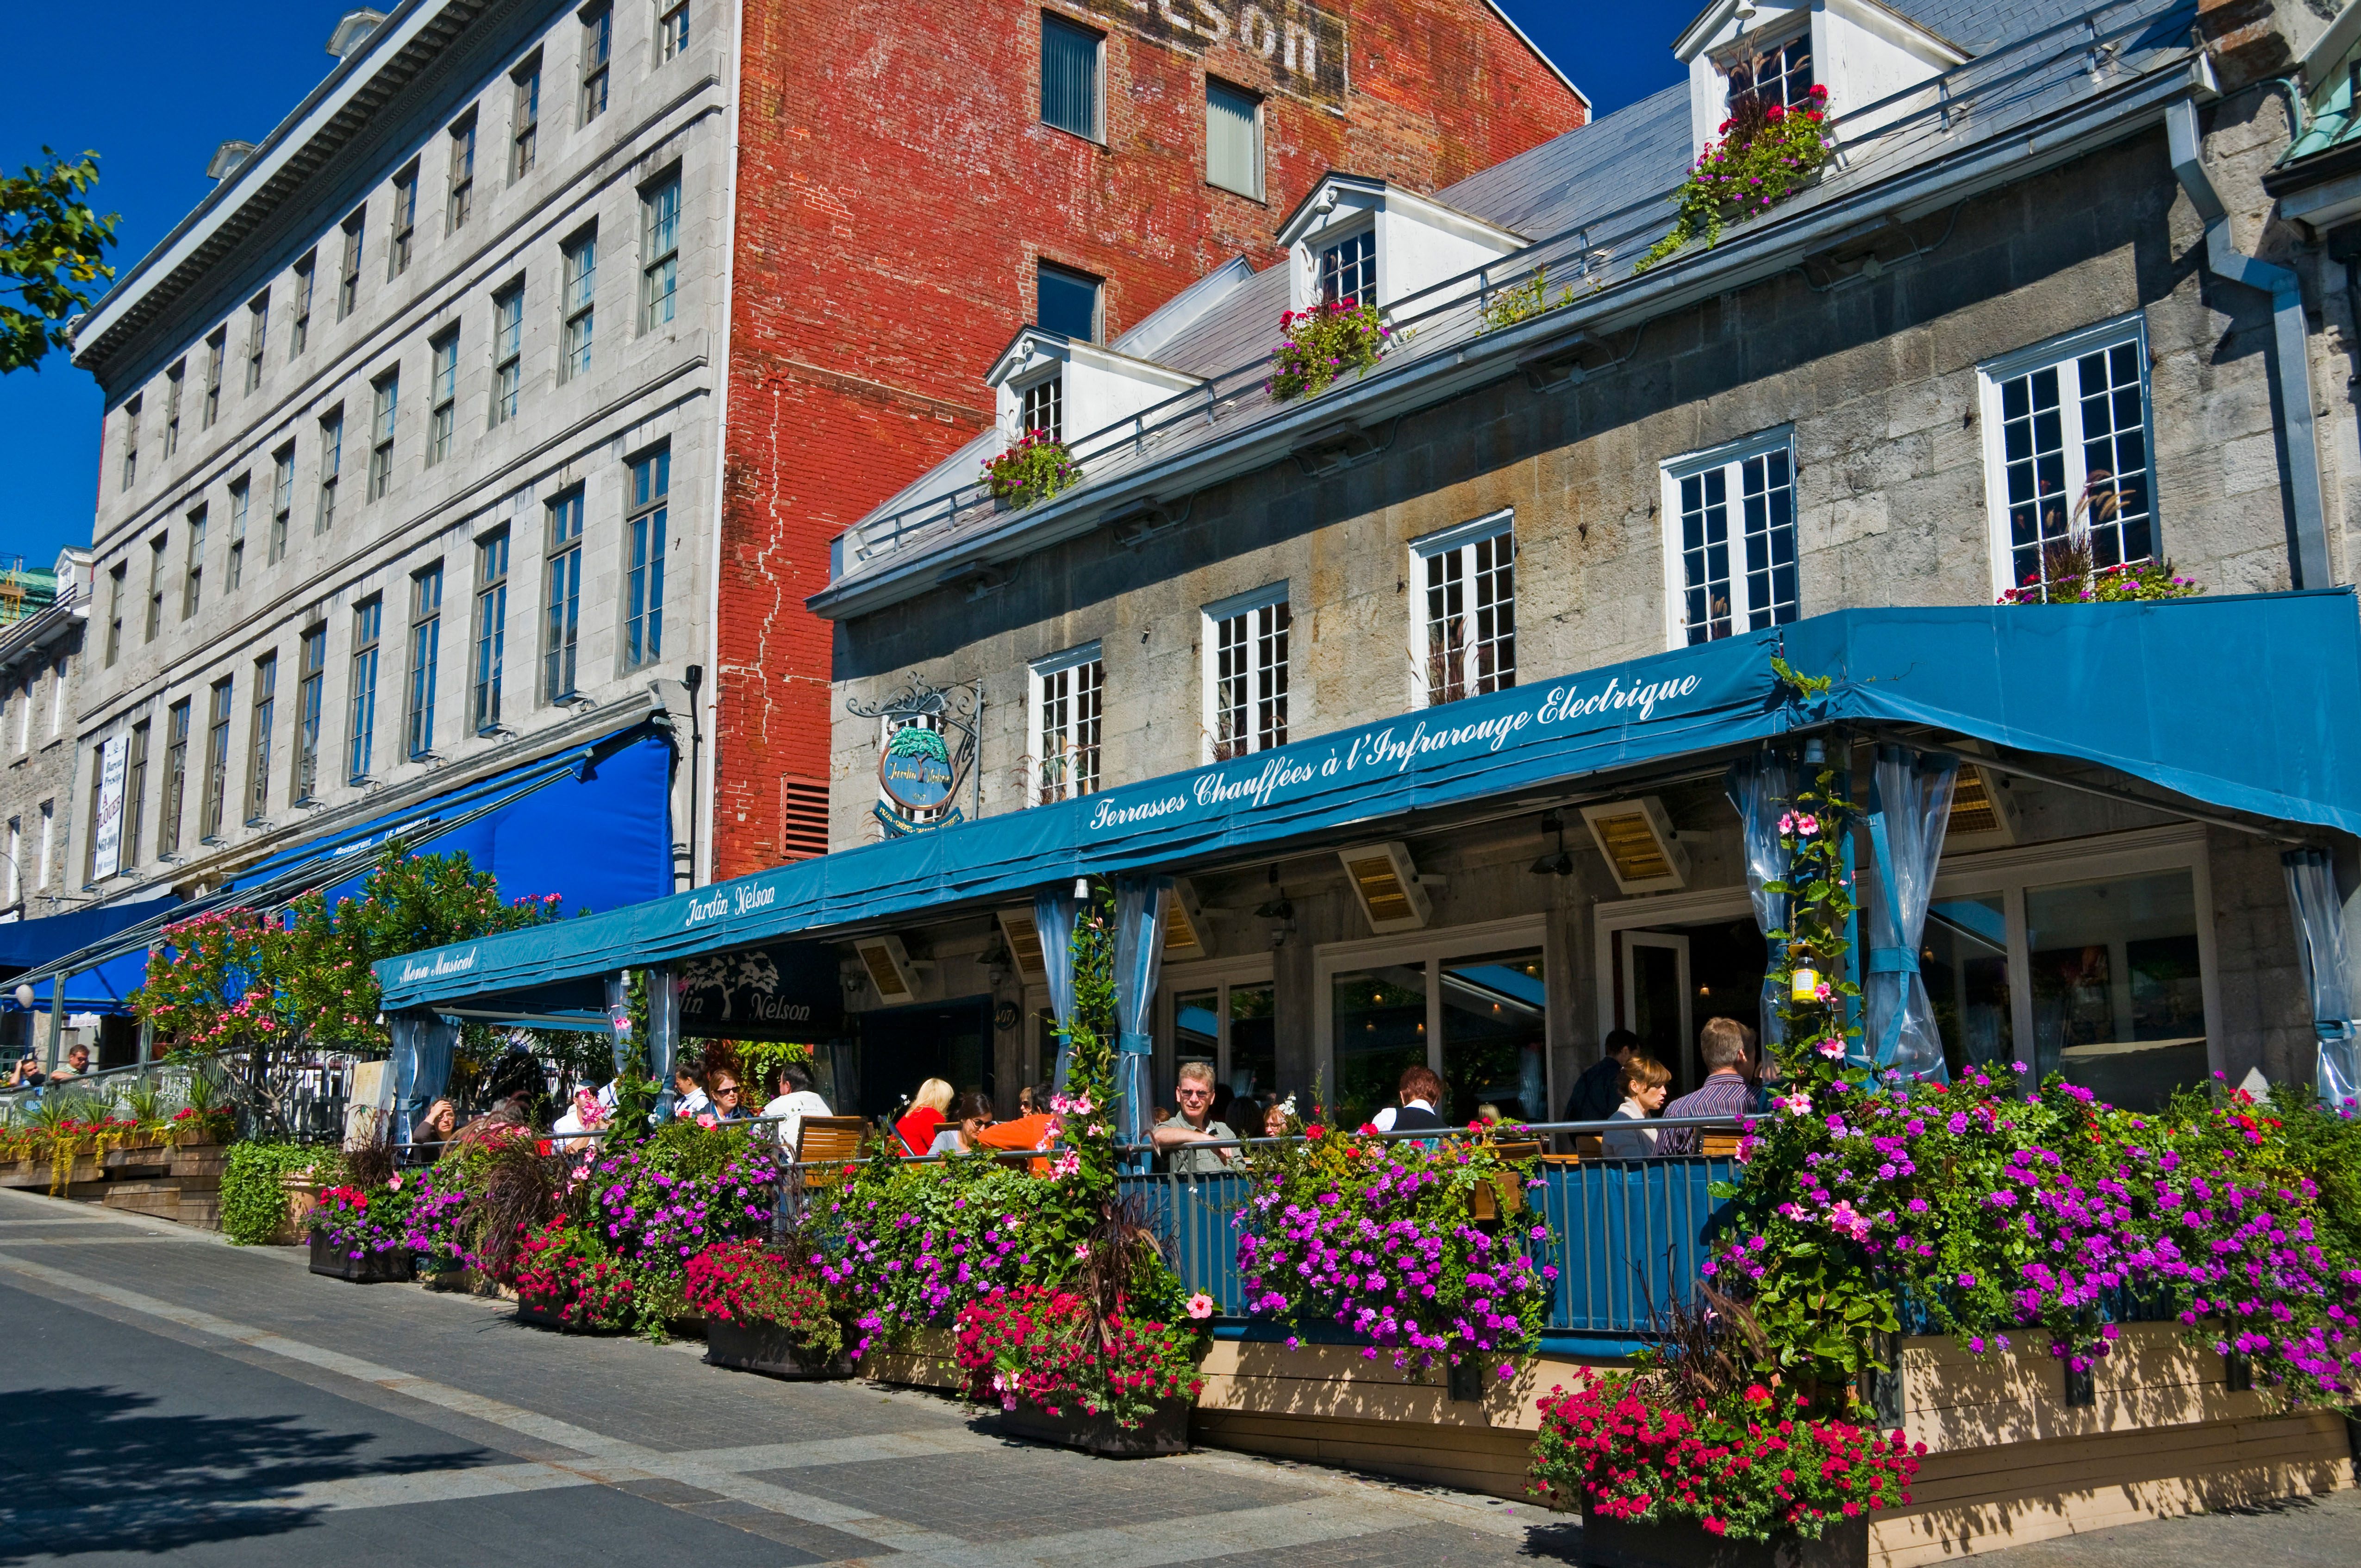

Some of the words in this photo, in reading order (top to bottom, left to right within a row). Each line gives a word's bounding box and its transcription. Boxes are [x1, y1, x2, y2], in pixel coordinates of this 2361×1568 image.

[1090, 793, 1188, 829] Terrasses
[1193, 756, 1317, 806] Chauffées
[1322, 749, 1341, 776] à
[686, 889, 728, 926] Jardin
[735, 882, 775, 915] Nelson
[431, 947, 477, 977] Musical
[749, 993, 810, 1021] Nelson
[994, 1009, 1012, 1023] 407
